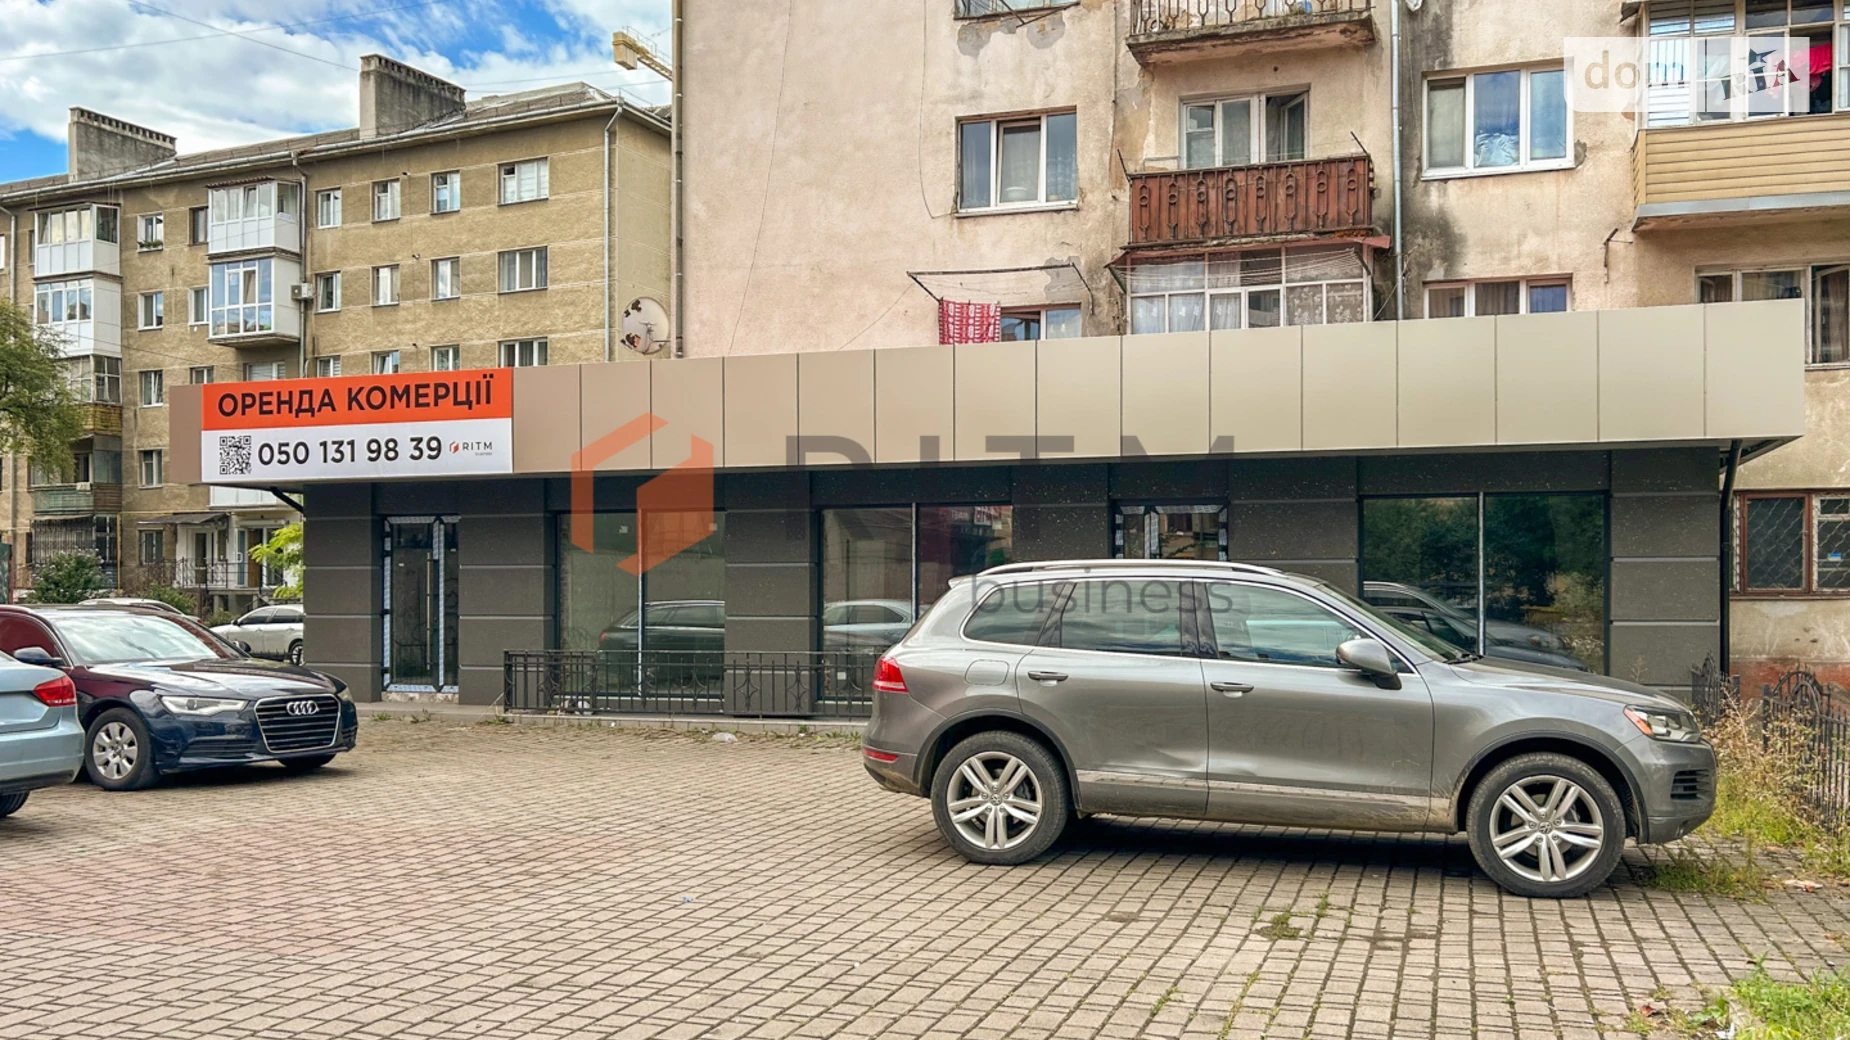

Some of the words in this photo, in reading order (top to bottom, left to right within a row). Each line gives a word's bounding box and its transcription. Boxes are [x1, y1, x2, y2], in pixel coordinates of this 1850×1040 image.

[218, 387, 336, 418] ОРЕНДА
[348, 374, 494, 411] КОМЕРЦІЇ
[258, 441, 310, 465] 050
[319, 439, 355, 463] 131
[366, 437, 399, 461] 98
[409, 436, 442, 460] 39
[462, 441, 493, 451] RITM
